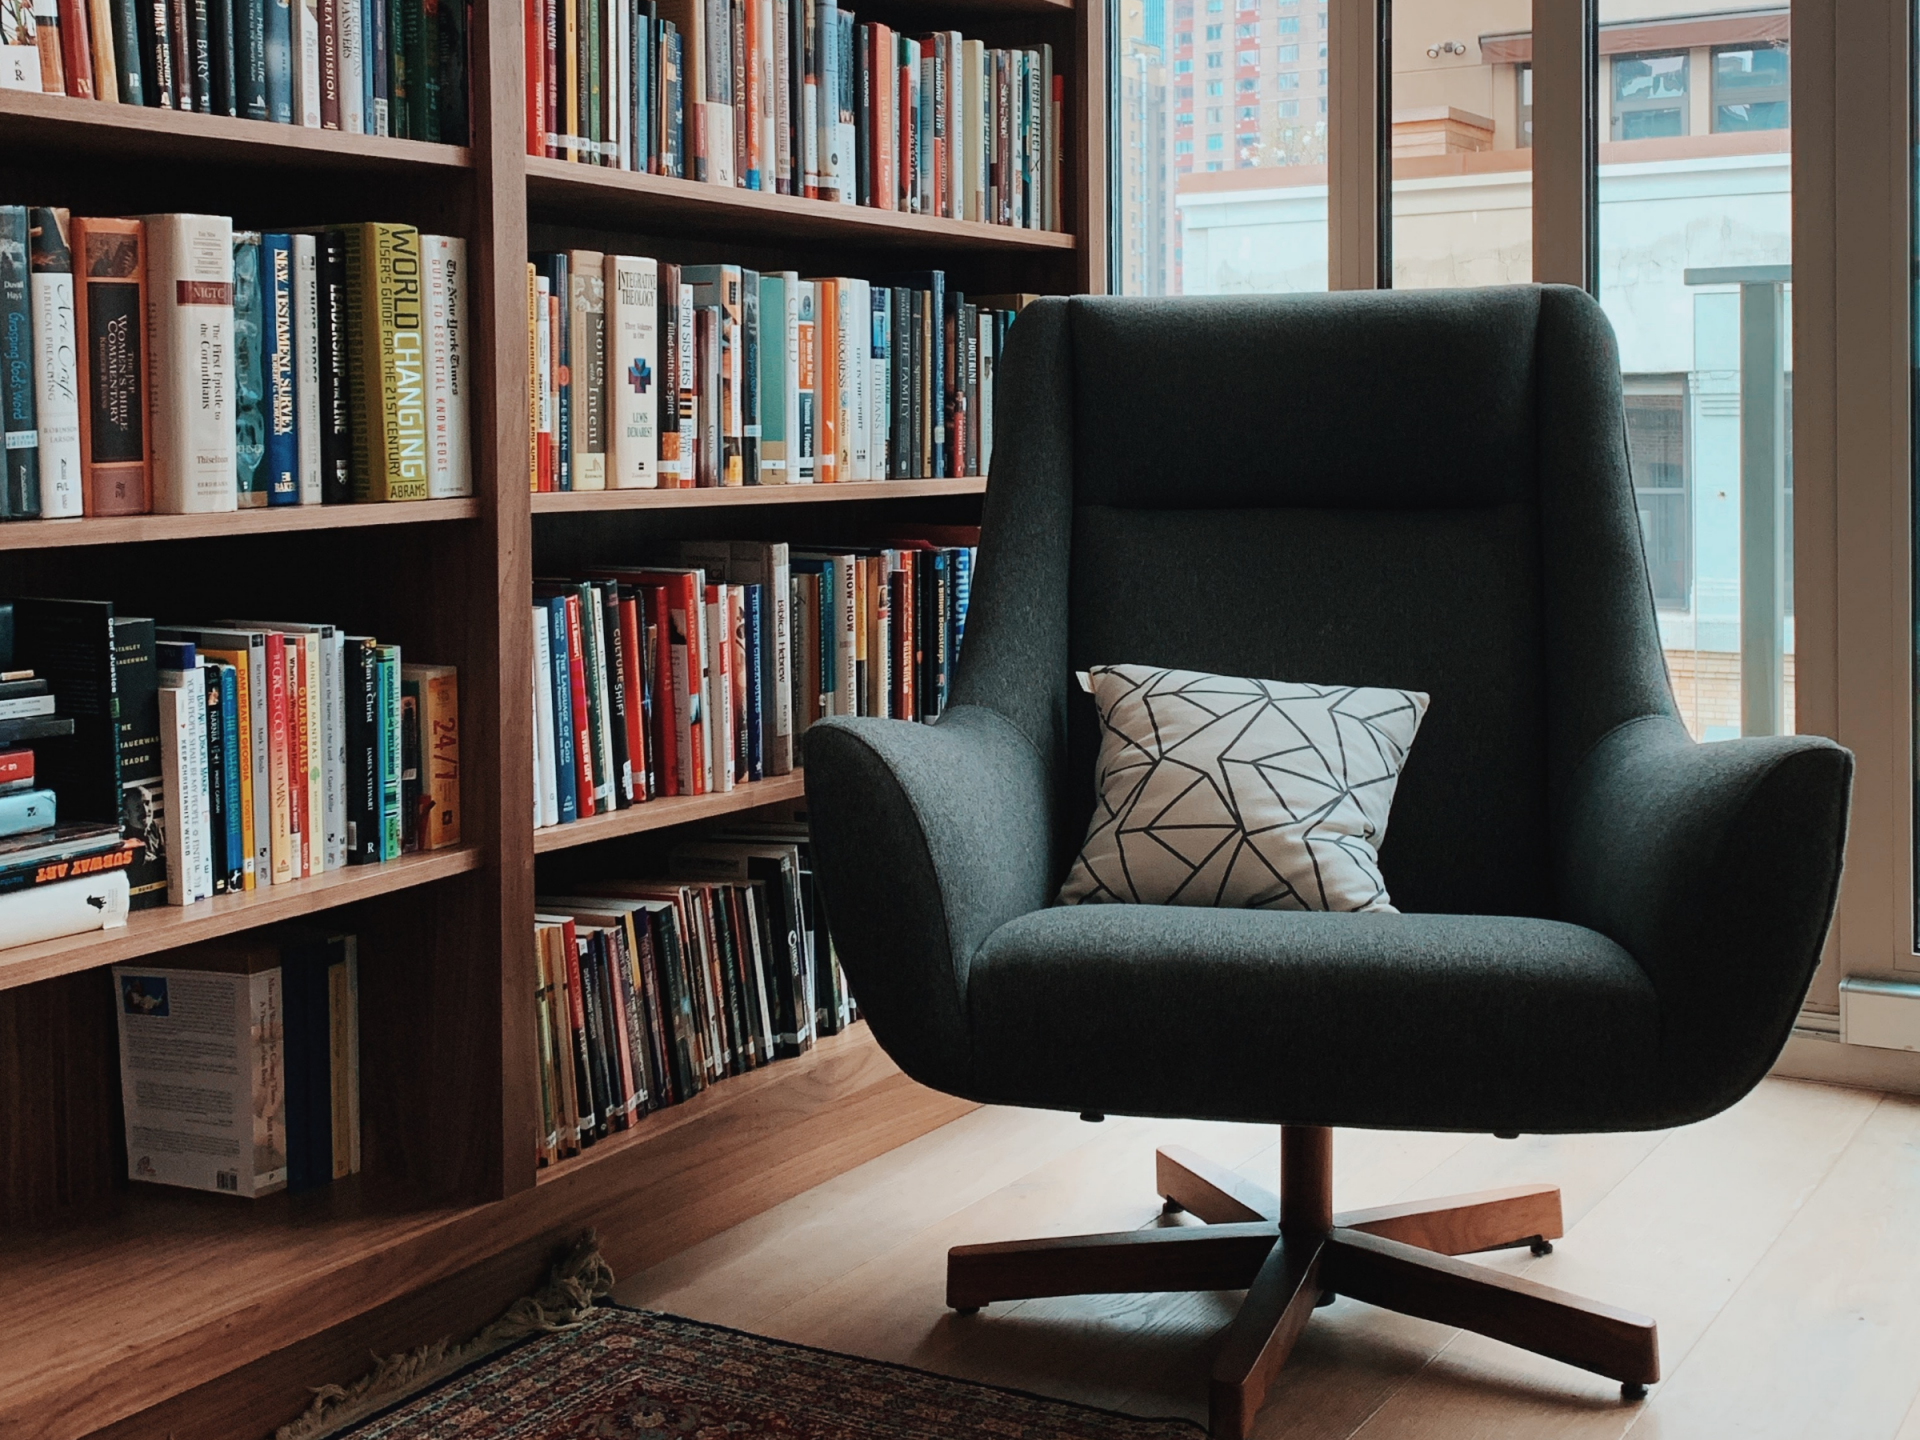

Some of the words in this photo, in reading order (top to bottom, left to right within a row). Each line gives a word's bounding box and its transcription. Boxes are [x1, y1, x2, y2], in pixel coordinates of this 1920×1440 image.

[256, 17, 265, 58] Human
[341, 7, 352, 60] ANSWERS
[163, 43, 172, 88] KENNEDY
[197, 39, 209, 83] BARY
[257, 61, 265, 83] Life
[325, 35, 335, 101] OMISSION
[736, 65, 746, 112] DARE
[1032, 67, 1041, 109] LOCUST
[778, 121, 790, 153] CULTURE
[1032, 112, 1041, 153] EFFECT
[379, 226, 390, 236] A
[275, 249, 289, 284] NEW
[379, 239, 393, 284] USER'S
[431, 259, 443, 297] GUIDE
[446, 259, 457, 284] The
[193, 287, 225, 299] NIGTC
[618, 269, 656, 290] INTEGRATIVE
[43, 285, 53, 332] BIBLICAL
[381, 286, 393, 327] GUIDE
[432, 304, 443, 318] TO
[447, 286, 458, 316] New
[622, 289, 654, 307] THEOLOGY
[681, 298, 692, 329] SPIN
[4, 312, 25, 359] Grasping
[200, 323, 208, 338] the
[212, 323, 220, 341] The
[276, 287, 291, 374] TESTAMENT
[329, 283, 346, 378] LEADERSHIP
[383, 329, 395, 356] FOR
[446, 318, 458, 352] York
[666, 321, 676, 347] Filled
[788, 297, 797, 363] CREED
[806, 327, 814, 341] The
[212, 343, 222, 368] First
[433, 325, 446, 391] ESSENTIAL
[595, 319, 604, 386] Stories
[666, 348, 675, 370] with
[681, 332, 692, 386] SISTERS
[806, 341, 814, 362] World
[837, 327, 847, 388] PROGRESS
[901, 333, 909, 362] THE
[967, 337, 977, 385] DOCTRINE
[45, 336, 55, 401] PREACHING
[200, 340, 212, 410] Corinthians
[384, 359, 396, 383] THE
[449, 354, 460, 396] Times
[666, 372, 675, 388] the
[12, 390, 29, 420] Word
[212, 371, 223, 407] Epistle
[384, 386, 398, 418] 21ST
[666, 389, 676, 415] Spirit
[901, 366, 909, 419] FAMILY
[214, 410, 221, 421] to
[279, 377, 293, 436] SURVEY
[333, 399, 347, 435] LINE
[588, 385, 599, 446] Intent
[632, 412, 648, 424] LEWIS
[804, 398, 812, 425] Thomas
[436, 398, 448, 473] KNOWLEDGE
[560, 398, 568, 451] PERMAN
[626, 426, 653, 439] DEMAREST
[196, 455, 229, 465] Thiselton
[386, 420, 400, 477] CENTURY
[390, 483, 427, 499] ABRAMS
[845, 563, 854, 632] KNOW-HOW
[938, 579, 945, 587] A
[777, 599, 786, 638] Biblical
[937, 588, 946, 615] Billion
[539, 625, 551, 671] blink
[612, 628, 624, 682] CULTURE
[936, 616, 946, 664] Bootstraps
[109, 653, 117, 693] Justice
[288, 657, 296, 682] What's
[365, 658, 374, 680] Man
[560, 652, 568, 673] THE
[778, 641, 787, 683] Hebrew
[847, 655, 855, 680] RAM
[187, 679, 196, 706] YOUR
[309, 660, 317, 707] MINISTRY
[366, 681, 374, 692] in
[561, 674, 570, 724] LANGUAGE
[614, 683, 625, 717] SHIFT
[239, 687, 247, 722] BREAK
[366, 692, 376, 723] Christ
[187, 707, 197, 737] PEOPLE
[209, 710, 217, 742] NARNIA
[241, 725, 248, 737] IN
[273, 711, 284, 741] GOD
[299, 686, 309, 774] GUARDRAILS
[563, 725, 570, 738] OF
[241, 737, 250, 781] GEORGIA
[432, 717, 458, 780] 24/7
[182, 764, 190, 826] CHRISTIANITY
[191, 795, 200, 825] PEOPLE
[35, 861, 69, 884] ART
[71, 850, 134, 876] SUBWAY
